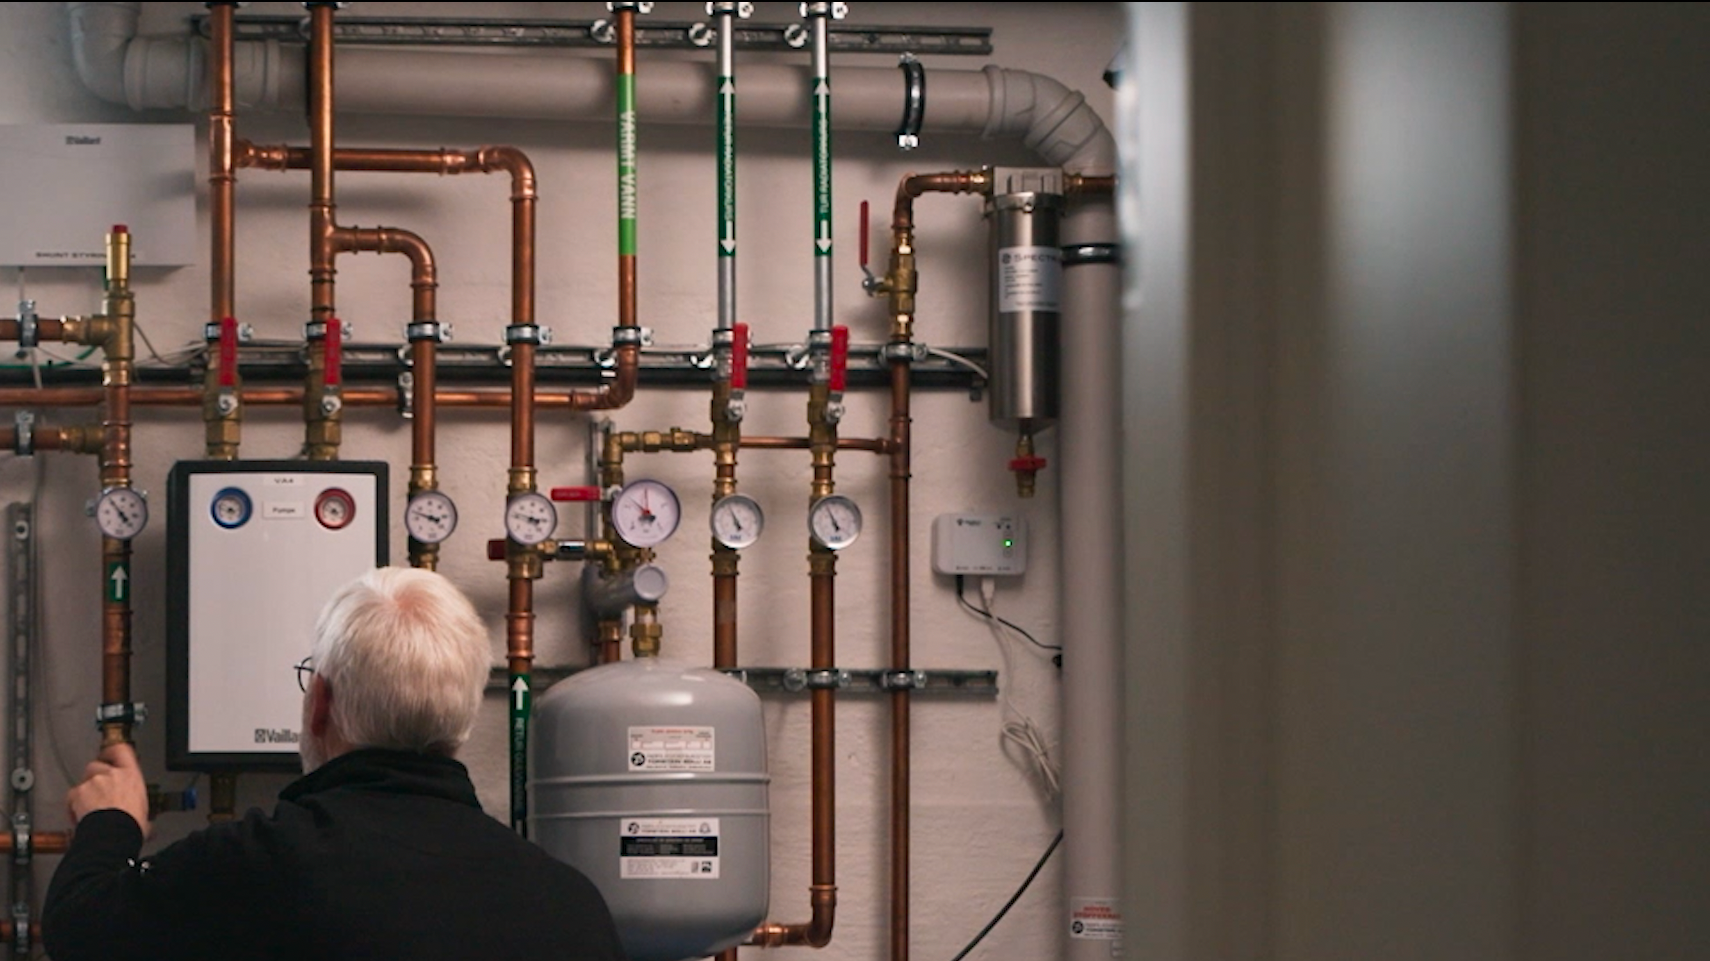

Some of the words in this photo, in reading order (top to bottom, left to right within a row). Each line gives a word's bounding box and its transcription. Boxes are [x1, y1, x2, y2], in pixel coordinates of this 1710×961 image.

[620, 111, 636, 167] VARMT
[621, 172, 636, 219] VANN
[266, 729, 300, 744] Vailla
